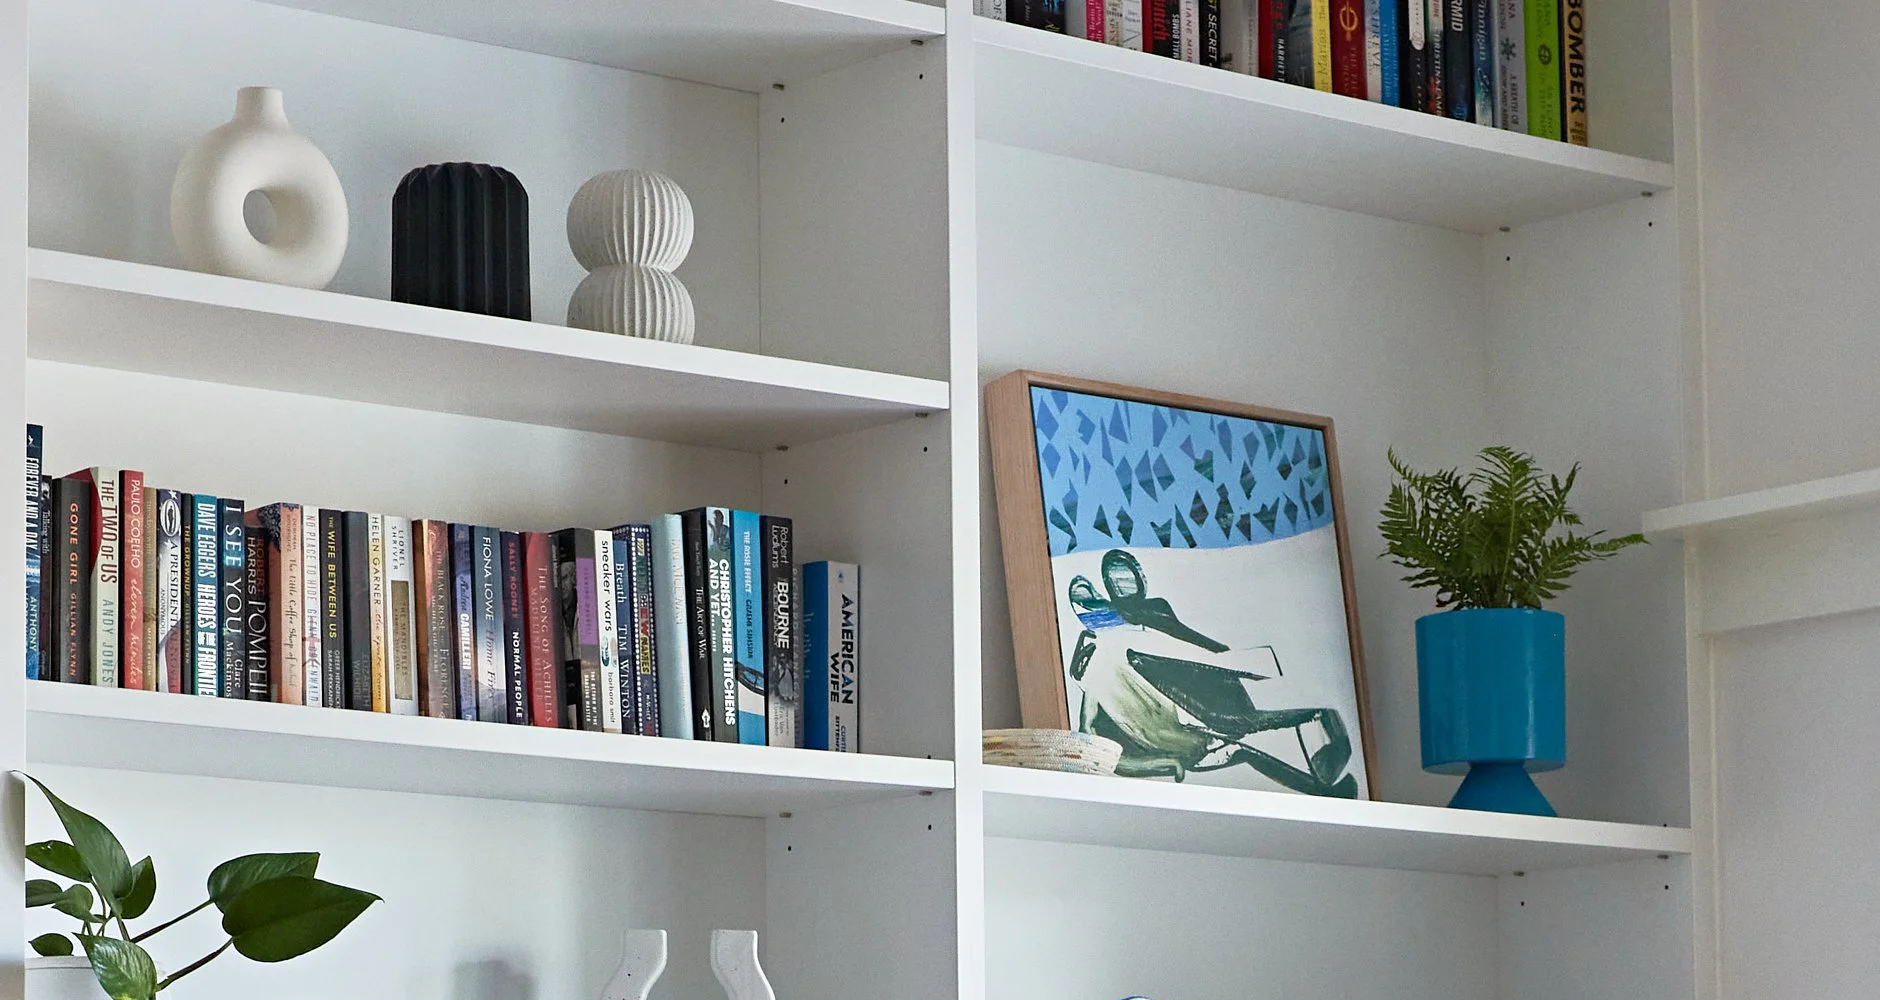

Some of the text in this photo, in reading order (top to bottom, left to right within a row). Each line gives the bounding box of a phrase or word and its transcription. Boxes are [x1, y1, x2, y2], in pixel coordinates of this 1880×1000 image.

[1185, 1, 1193, 34] LIANE
[1208, 13, 1217, 61] SECRET
[1277, 38, 1285, 74] HARRIET
[1433, 27, 1441, 85] CHRISTINA
[1567, 0, 1585, 113] BOMBER
[26, 457, 39, 499] FOREVER
[26, 499, 39, 519] AND
[197, 503, 216, 532] DAVE
[306, 515, 315, 529] NO
[26, 530, 38, 550] DAY
[41, 510, 51, 554] Talking with
[225, 525, 242, 568] SEE
[306, 531, 316, 560] PLACE
[327, 530, 336, 559] WIFE
[391, 525, 399, 570] SHRIVER
[397, 529, 405, 568] LIONEL
[779, 526, 789, 564] Robert
[129, 479, 142, 630] PAULO COELHO eleven
[198, 534, 217, 577] EGGERS
[247, 537, 256, 595] HARRIS
[256, 537, 264, 593] ROBERT
[306, 565, 316, 577] TO
[371, 516, 382, 605] HELEN GARNER
[482, 537, 492, 578] FIONA
[601, 540, 612, 595] sneaker
[709, 557, 720, 590] AND
[743, 545, 751, 566] ROSIE
[69, 502, 79, 676] GONE GIRL GILLIAN FLYNN
[100, 479, 118, 684] THE TWO OF US ANDY JONES
[306, 580, 317, 602] HIDE
[327, 563, 337, 618] BETWEEN
[459, 577, 469, 611] Andrea
[696, 586, 704, 604] THE
[744, 567, 752, 594] EFFECT
[198, 583, 217, 629] HEROES
[224, 577, 242, 634] YOU
[285, 559, 297, 663] The Little Coffee Shop of
[437, 605, 446, 631] ROSE
[484, 583, 494, 621] LOWE
[530, 587, 541, 652] MADELINE
[604, 599, 613, 632] wars
[697, 606, 705, 624] ART
[777, 581, 789, 649] BOURNE
[29, 596, 38, 651] ANTHONY
[307, 608, 317, 639] GLENN
[329, 623, 337, 639] US
[460, 613, 472, 670] CAMILLERI
[508, 542, 523, 719] SALLY ROONEY NORMAL PEOPLE
[538, 566, 553, 723] THE SONG OF ACHILLES
[615, 563, 631, 719] Breath TIM WINTON
[698, 625, 704, 637] OF
[718, 558, 735, 725] CHRISTOPHER HITCHENS
[248, 600, 267, 694] POMPEII
[486, 631, 495, 666] Home
[640, 637, 651, 675] NAMES
[698, 637, 706, 659] WAR
[841, 594, 854, 705] AMERICAN
[198, 647, 217, 697] FRONTIE
[234, 659, 243, 689] Clare
[352, 660, 362, 701] WILHIDE
[362, 654, 370, 707] ELIZABETH
[439, 648, 450, 709] FLORENCE
[608, 671, 616, 706] barbara
[830, 652, 840, 703] WIFE
